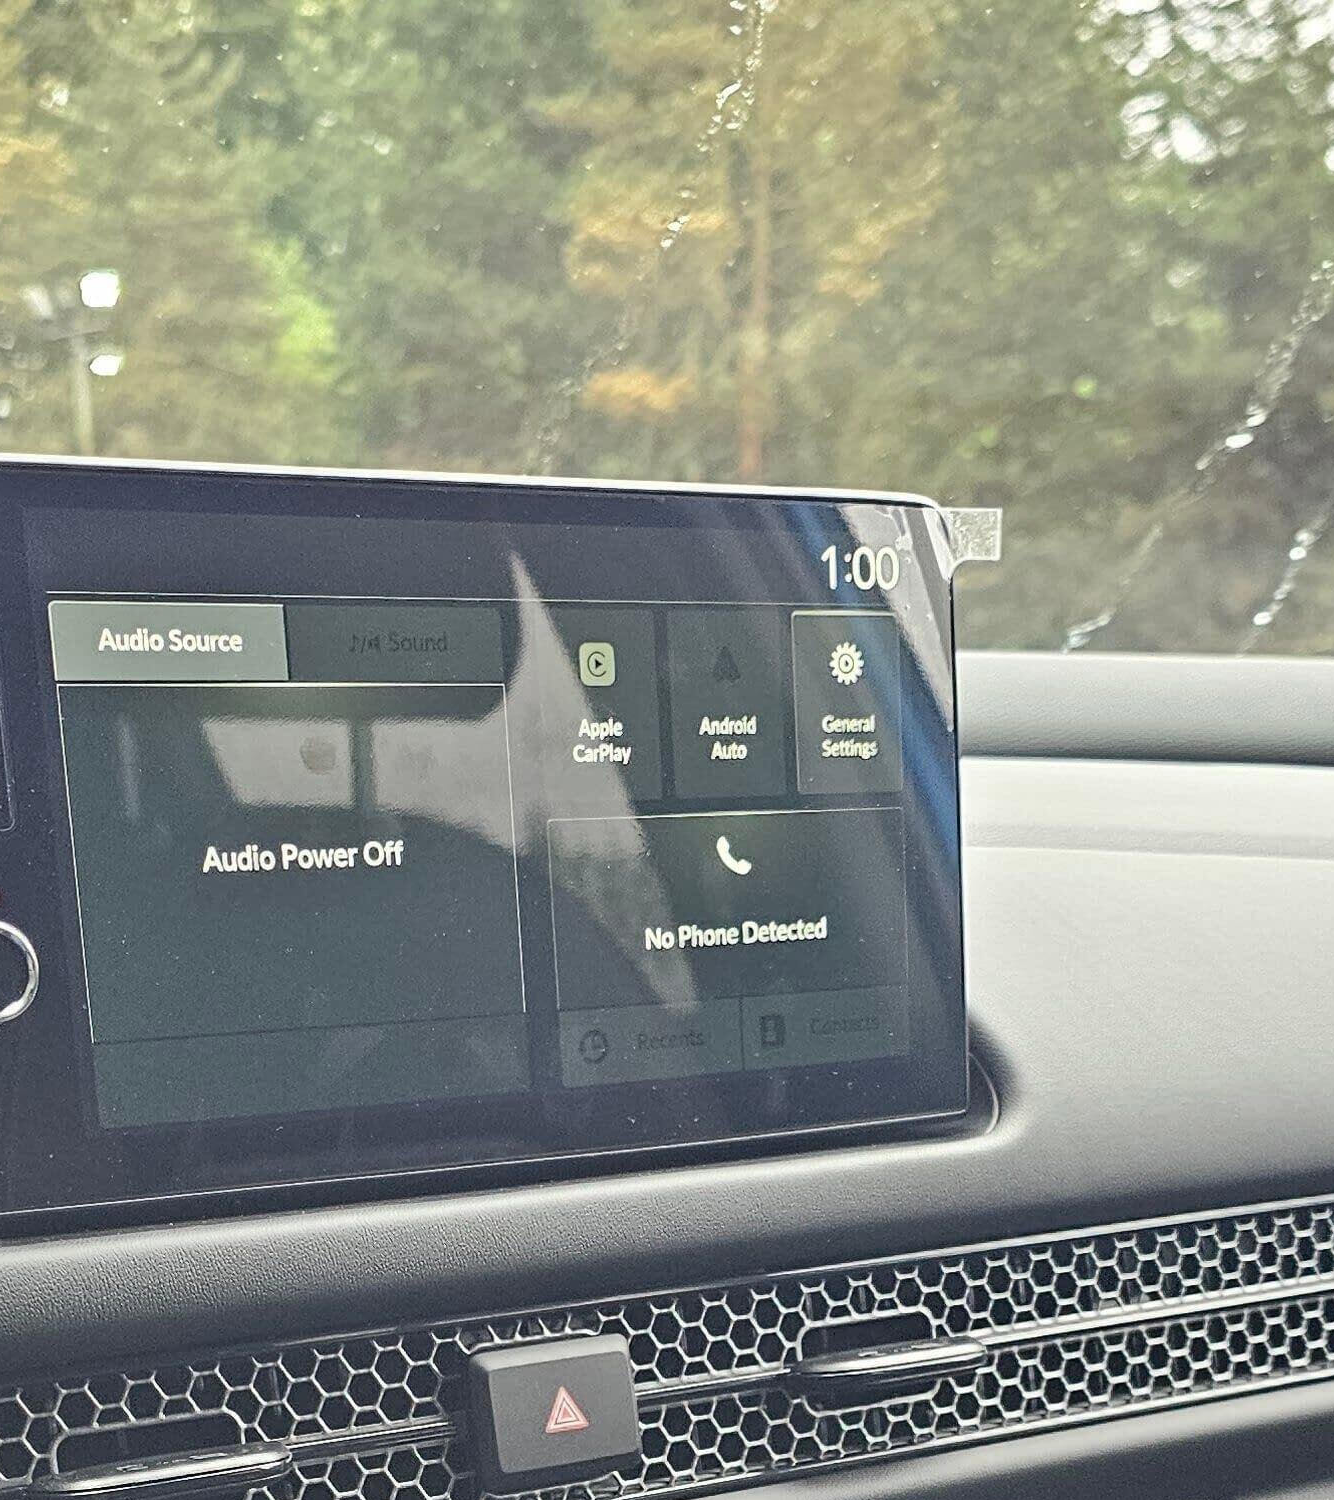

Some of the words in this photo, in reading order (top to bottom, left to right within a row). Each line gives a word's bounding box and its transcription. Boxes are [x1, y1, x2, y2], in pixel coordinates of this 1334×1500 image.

[820, 545, 901, 591] 1:00
[97, 628, 164, 654] Audio
[167, 630, 244, 654] Source
[387, 631, 448, 653] Sound
[578, 718, 624, 741] Apple
[698, 716, 758, 738] Android
[821, 714, 876, 736] General
[572, 742, 632, 767] CarPlay
[710, 740, 748, 761] Auto
[821, 739, 879, 761] Settings
[202, 845, 277, 873] Audio
[282, 843, 359, 871] Power
[363, 840, 405, 867] Off
[644, 927, 675, 951] No
[677, 921, 739, 949] Phone
[742, 917, 828, 946] Detected
